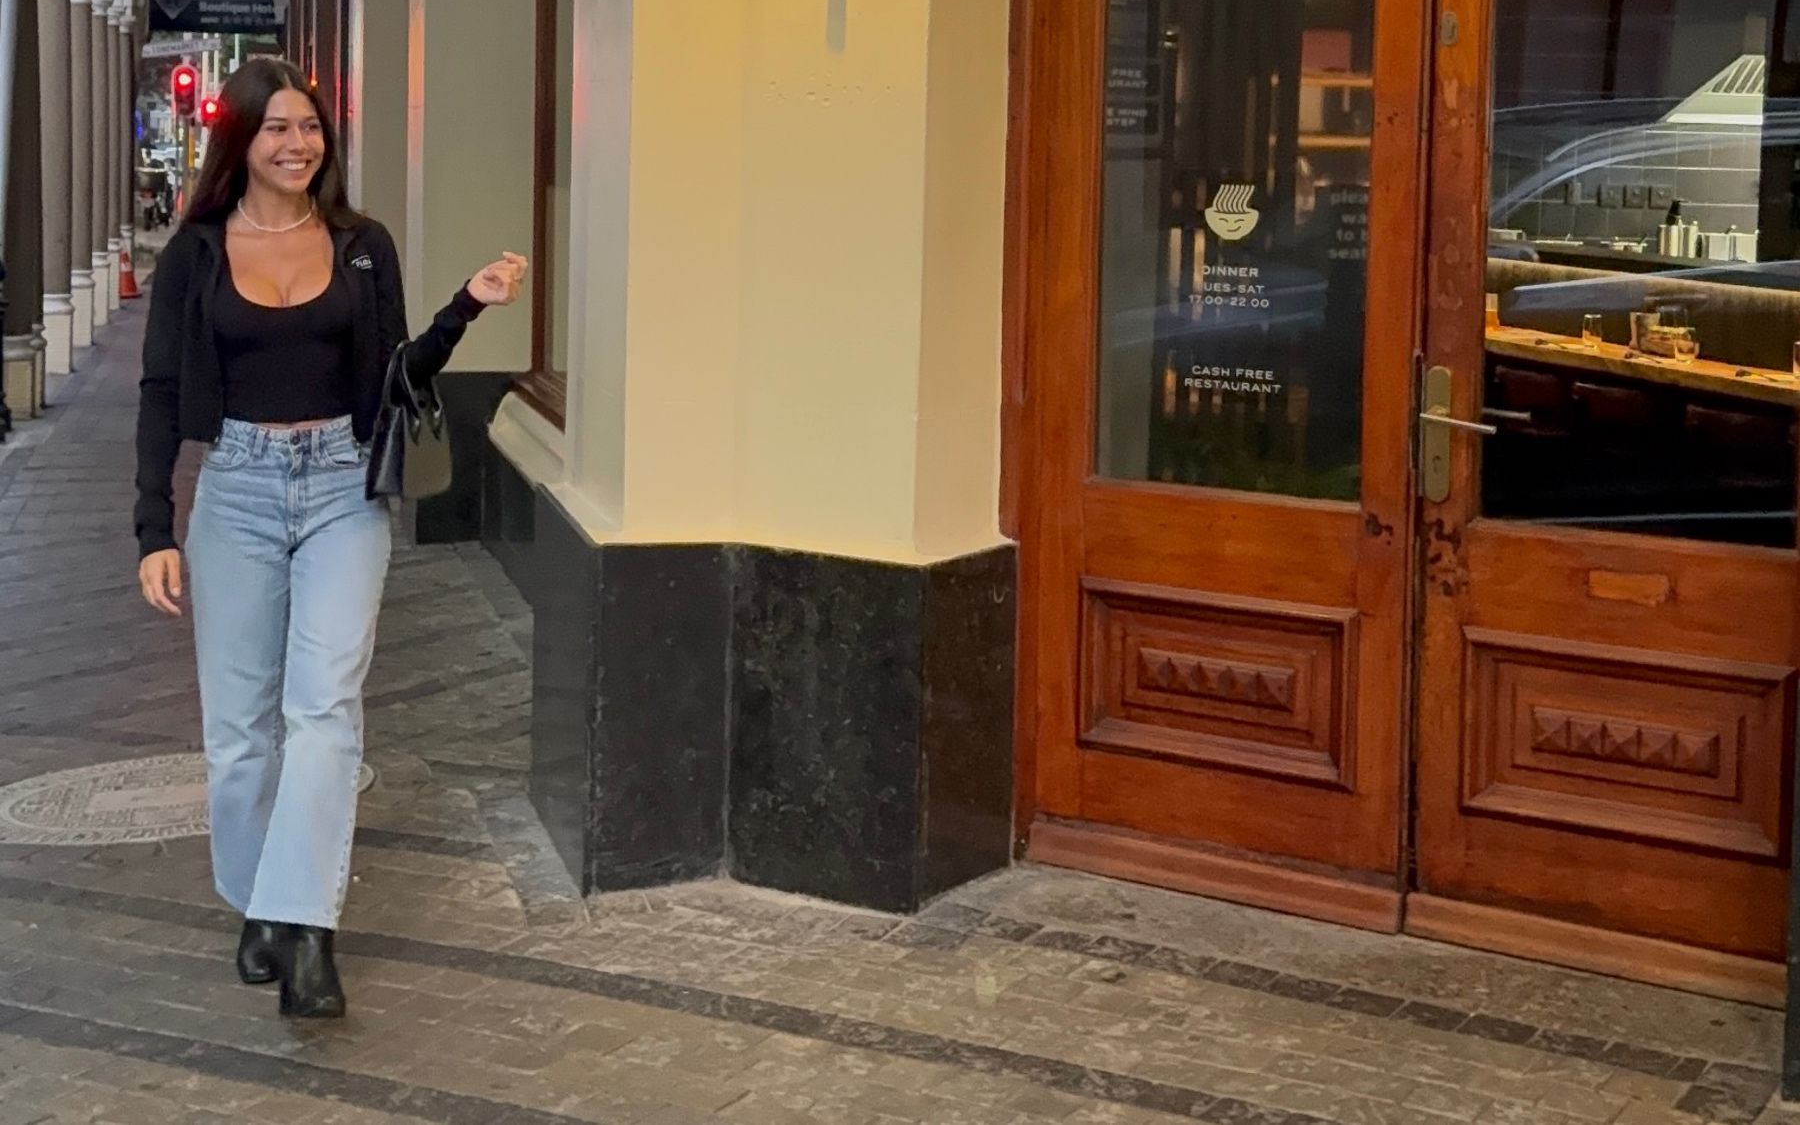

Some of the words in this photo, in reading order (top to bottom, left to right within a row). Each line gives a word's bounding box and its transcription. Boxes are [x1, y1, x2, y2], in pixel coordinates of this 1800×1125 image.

[252, 3, 273, 14] Hot
[1201, 265, 1260, 278] DINNER
[1197, 282, 1265, 294] UES-SAT
[1192, 365, 1231, 377] CASH
[1236, 367, 1275, 381] FREE
[1184, 377, 1282, 394] RESTAURANT
